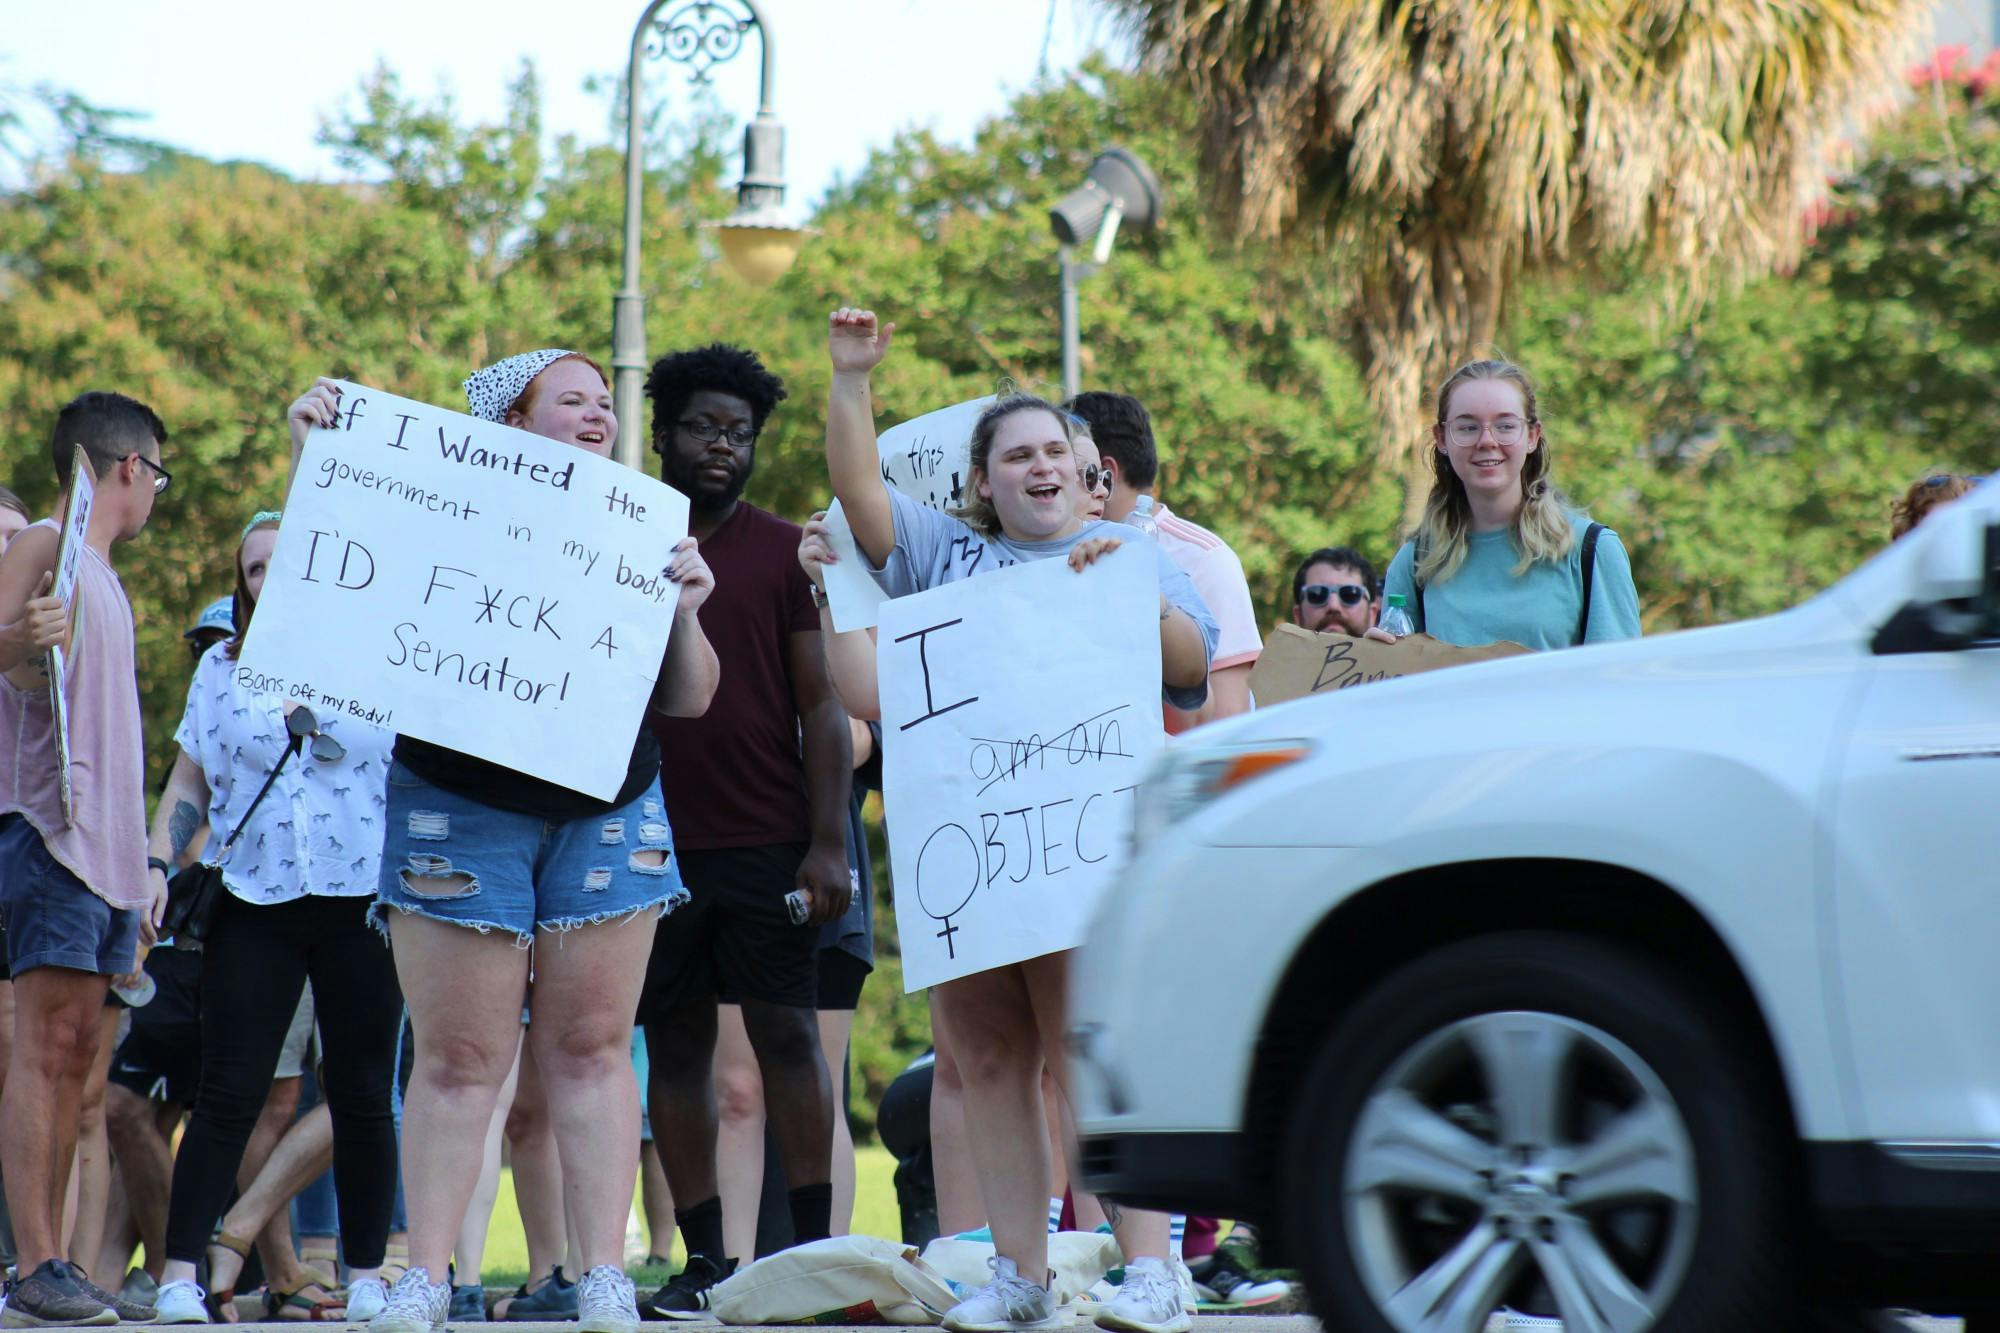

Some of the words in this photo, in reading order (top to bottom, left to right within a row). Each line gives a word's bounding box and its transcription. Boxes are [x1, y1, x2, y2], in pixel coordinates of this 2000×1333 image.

[387, 414, 419, 450] I
[438, 426, 575, 491] Wanted
[605, 486, 647, 522] the
[908, 435, 945, 480] this
[315, 457, 480, 521] government
[507, 517, 532, 542] in
[563, 540, 601, 576] my
[300, 530, 375, 590] I'D
[590, 627, 619, 659] A
[237, 667, 284, 692] Bans
[289, 683, 317, 701] off
[321, 694, 345, 711] my
[348, 700, 393, 726] Body!
[386, 622, 571, 710] Senator!
[894, 618, 979, 730] I
[1067, 719, 1122, 765] an
